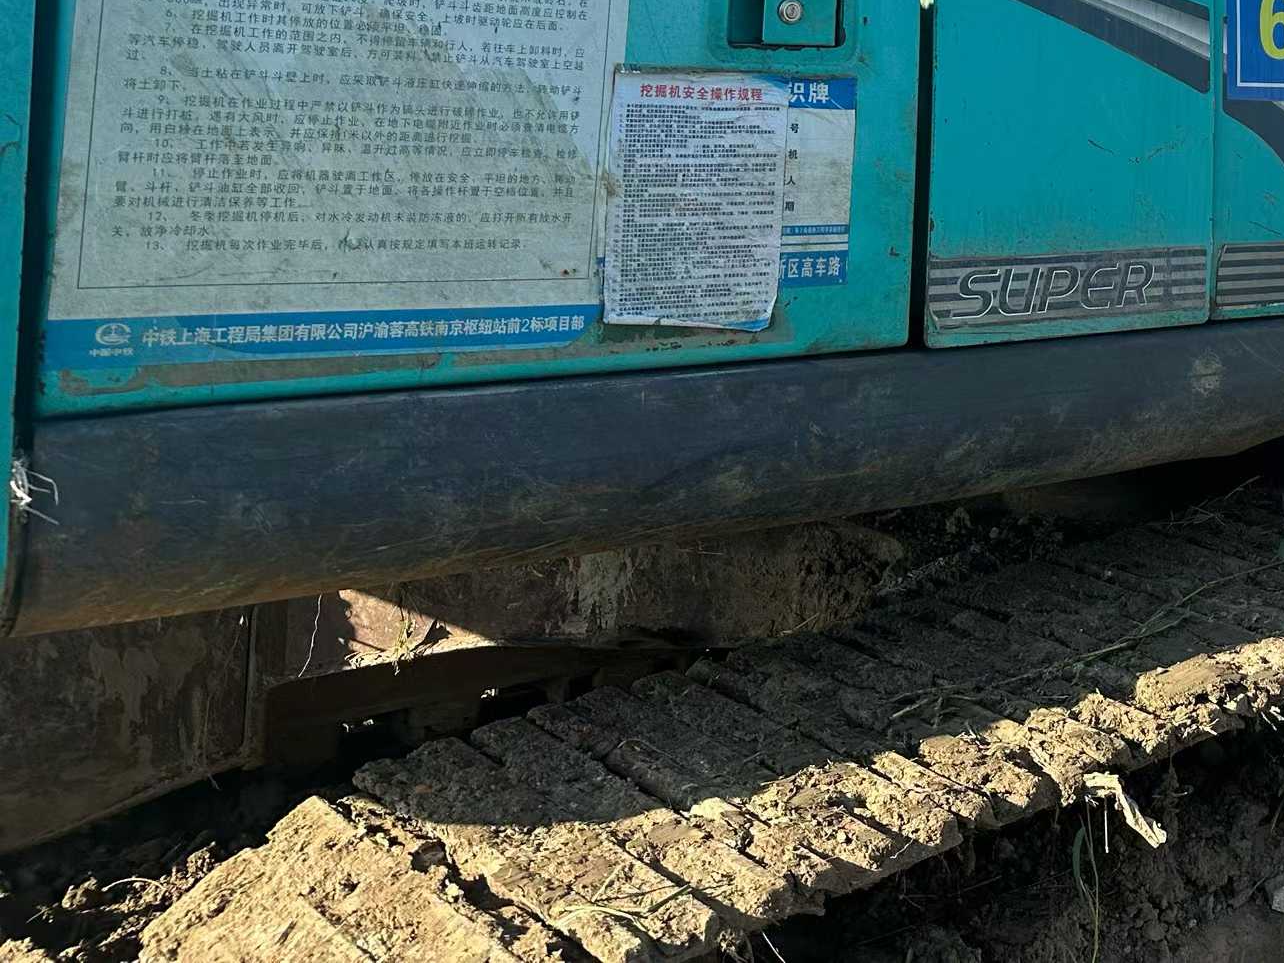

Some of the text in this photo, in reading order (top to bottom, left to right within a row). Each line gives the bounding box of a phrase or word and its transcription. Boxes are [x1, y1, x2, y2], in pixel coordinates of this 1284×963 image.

[640, 83, 763, 101] 挖掘机安全操作规程
[951, 260, 1155, 320] SUPER
